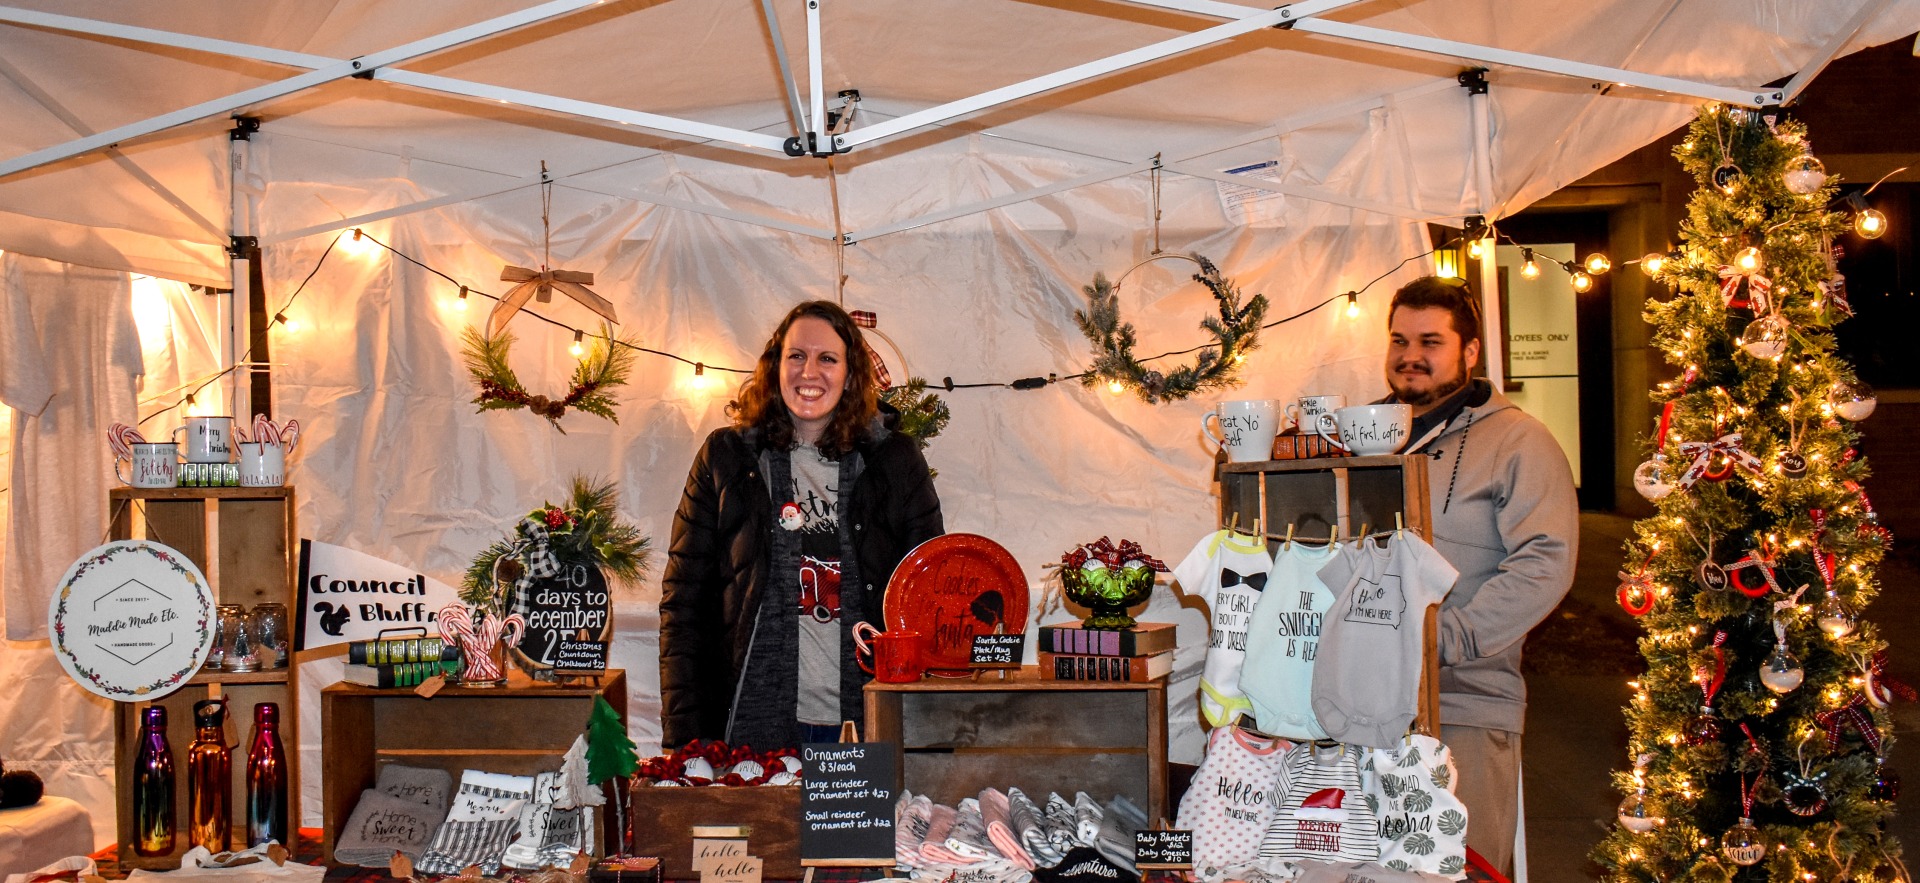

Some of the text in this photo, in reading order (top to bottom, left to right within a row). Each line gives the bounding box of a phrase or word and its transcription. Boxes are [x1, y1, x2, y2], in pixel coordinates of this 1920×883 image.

[1510, 333, 1570, 342] LOYEES ONLY
[199, 425, 220, 441] Mrry
[1224, 428, 1243, 446] Self
[1343, 420, 1357, 442] But
[555, 564, 588, 589] 40
[310, 574, 426, 596] Council
[536, 588, 608, 608] days to
[1217, 592, 1231, 605] ERY
[1231, 593, 1251, 613] GIRL
[1298, 590, 1315, 611] THE
[87, 607, 179, 637] Maddie Made Etc.
[528, 605, 606, 629] ecember
[1365, 608, 1377, 619] NEW
[1377, 609, 1393, 620] HERE
[1278, 612, 1323, 637] SNUGG
[560, 641, 603, 651] Christmas
[975, 635, 1021, 644] Santa Cookie
[558, 650, 602, 659] Countdown
[1286, 638, 1296, 658] IS
[556, 659, 606, 669] Chalkboard $22
[994, 654, 1012, 663] $25
[804, 746, 866, 761] Ornaments
[400, 782, 433, 797] Home
[805, 779, 869, 792] Large reindeer
[1218, 776, 1266, 806] Hello
[1401, 774, 1420, 793] HAD
[809, 788, 890, 801] ornament set $27
[466, 799, 500, 814] Merry
[1389, 799, 1400, 812] ME
[382, 809, 417, 826] Home
[805, 810, 866, 821] Small reindeer
[1232, 808, 1243, 820] NEW
[1243, 811, 1259, 823] HERE
[372, 820, 415, 840] Sweet
[811, 817, 892, 831] ornament set $22
[1297, 819, 1342, 833] MERRY
[1136, 831, 1191, 847] Baby Blankets
[1294, 832, 1341, 853] CHRISTMAS
[698, 842, 742, 858] hello
[1137, 848, 1190, 859] Baby Onesies
[713, 860, 756, 878] hello
